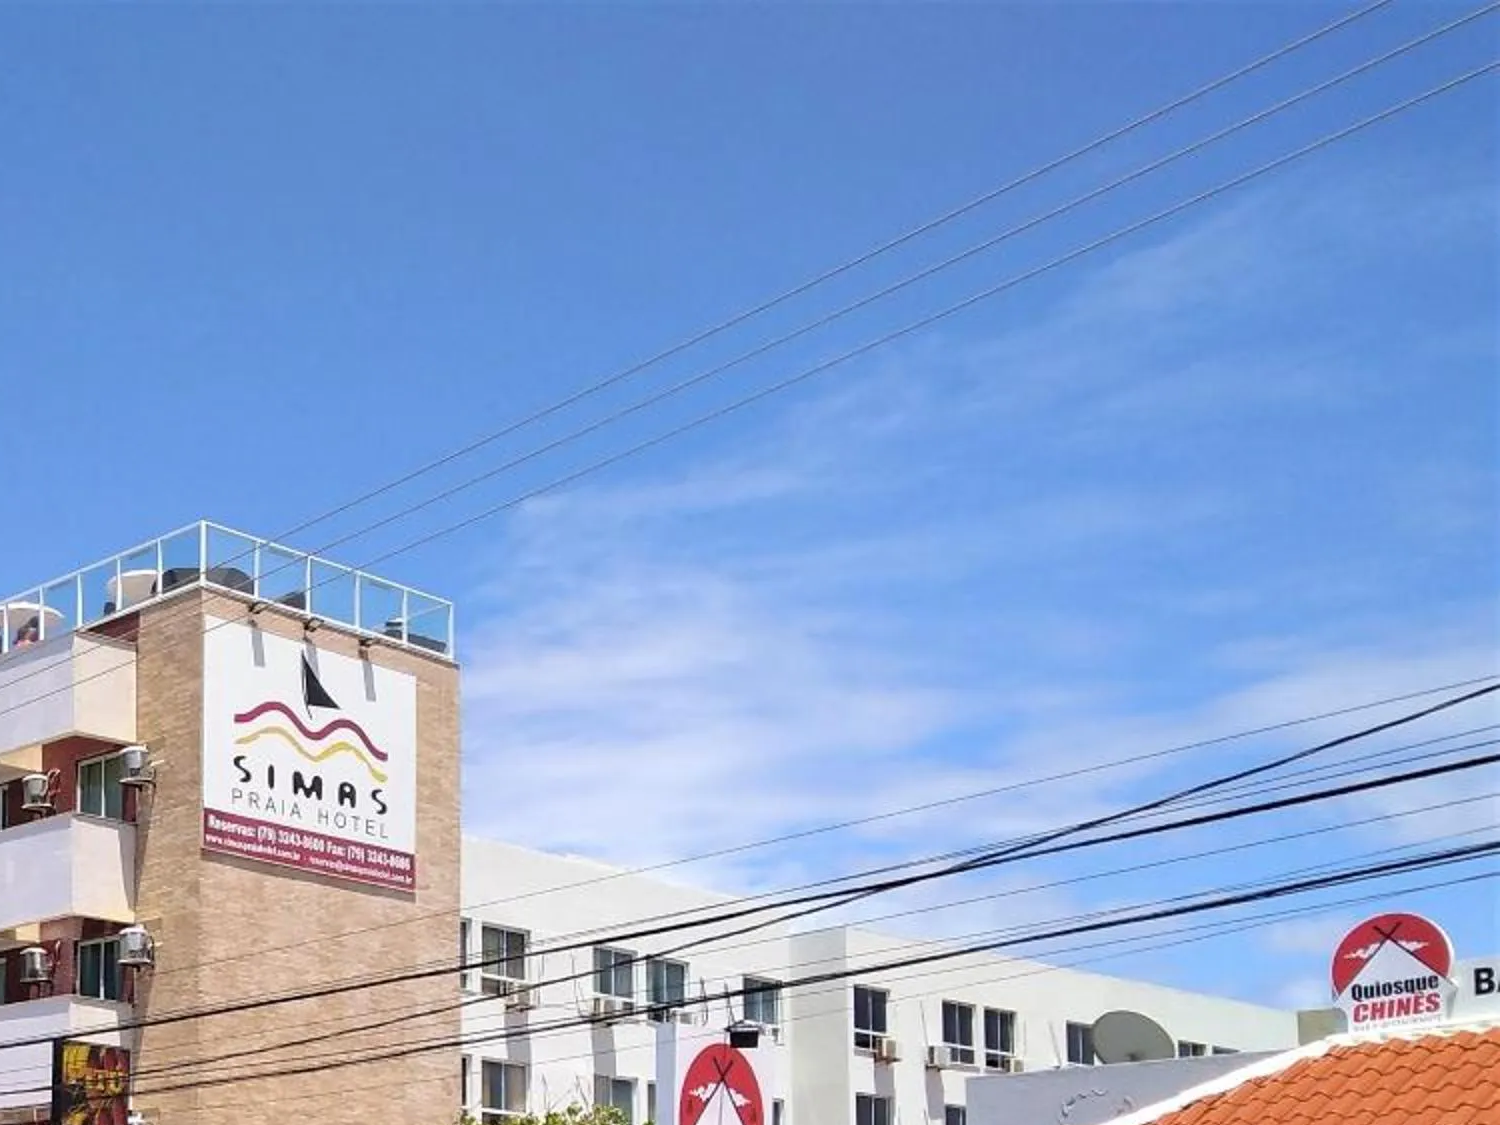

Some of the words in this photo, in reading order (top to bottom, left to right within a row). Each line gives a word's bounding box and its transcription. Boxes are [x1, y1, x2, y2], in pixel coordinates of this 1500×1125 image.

[233, 755, 388, 815] SIMAS
[231, 788, 302, 818] PRAIA
[317, 810, 389, 839] HOTEL
[1351, 975, 1439, 1002] Quiosque
[1353, 990, 1440, 1023] CHINÊS
